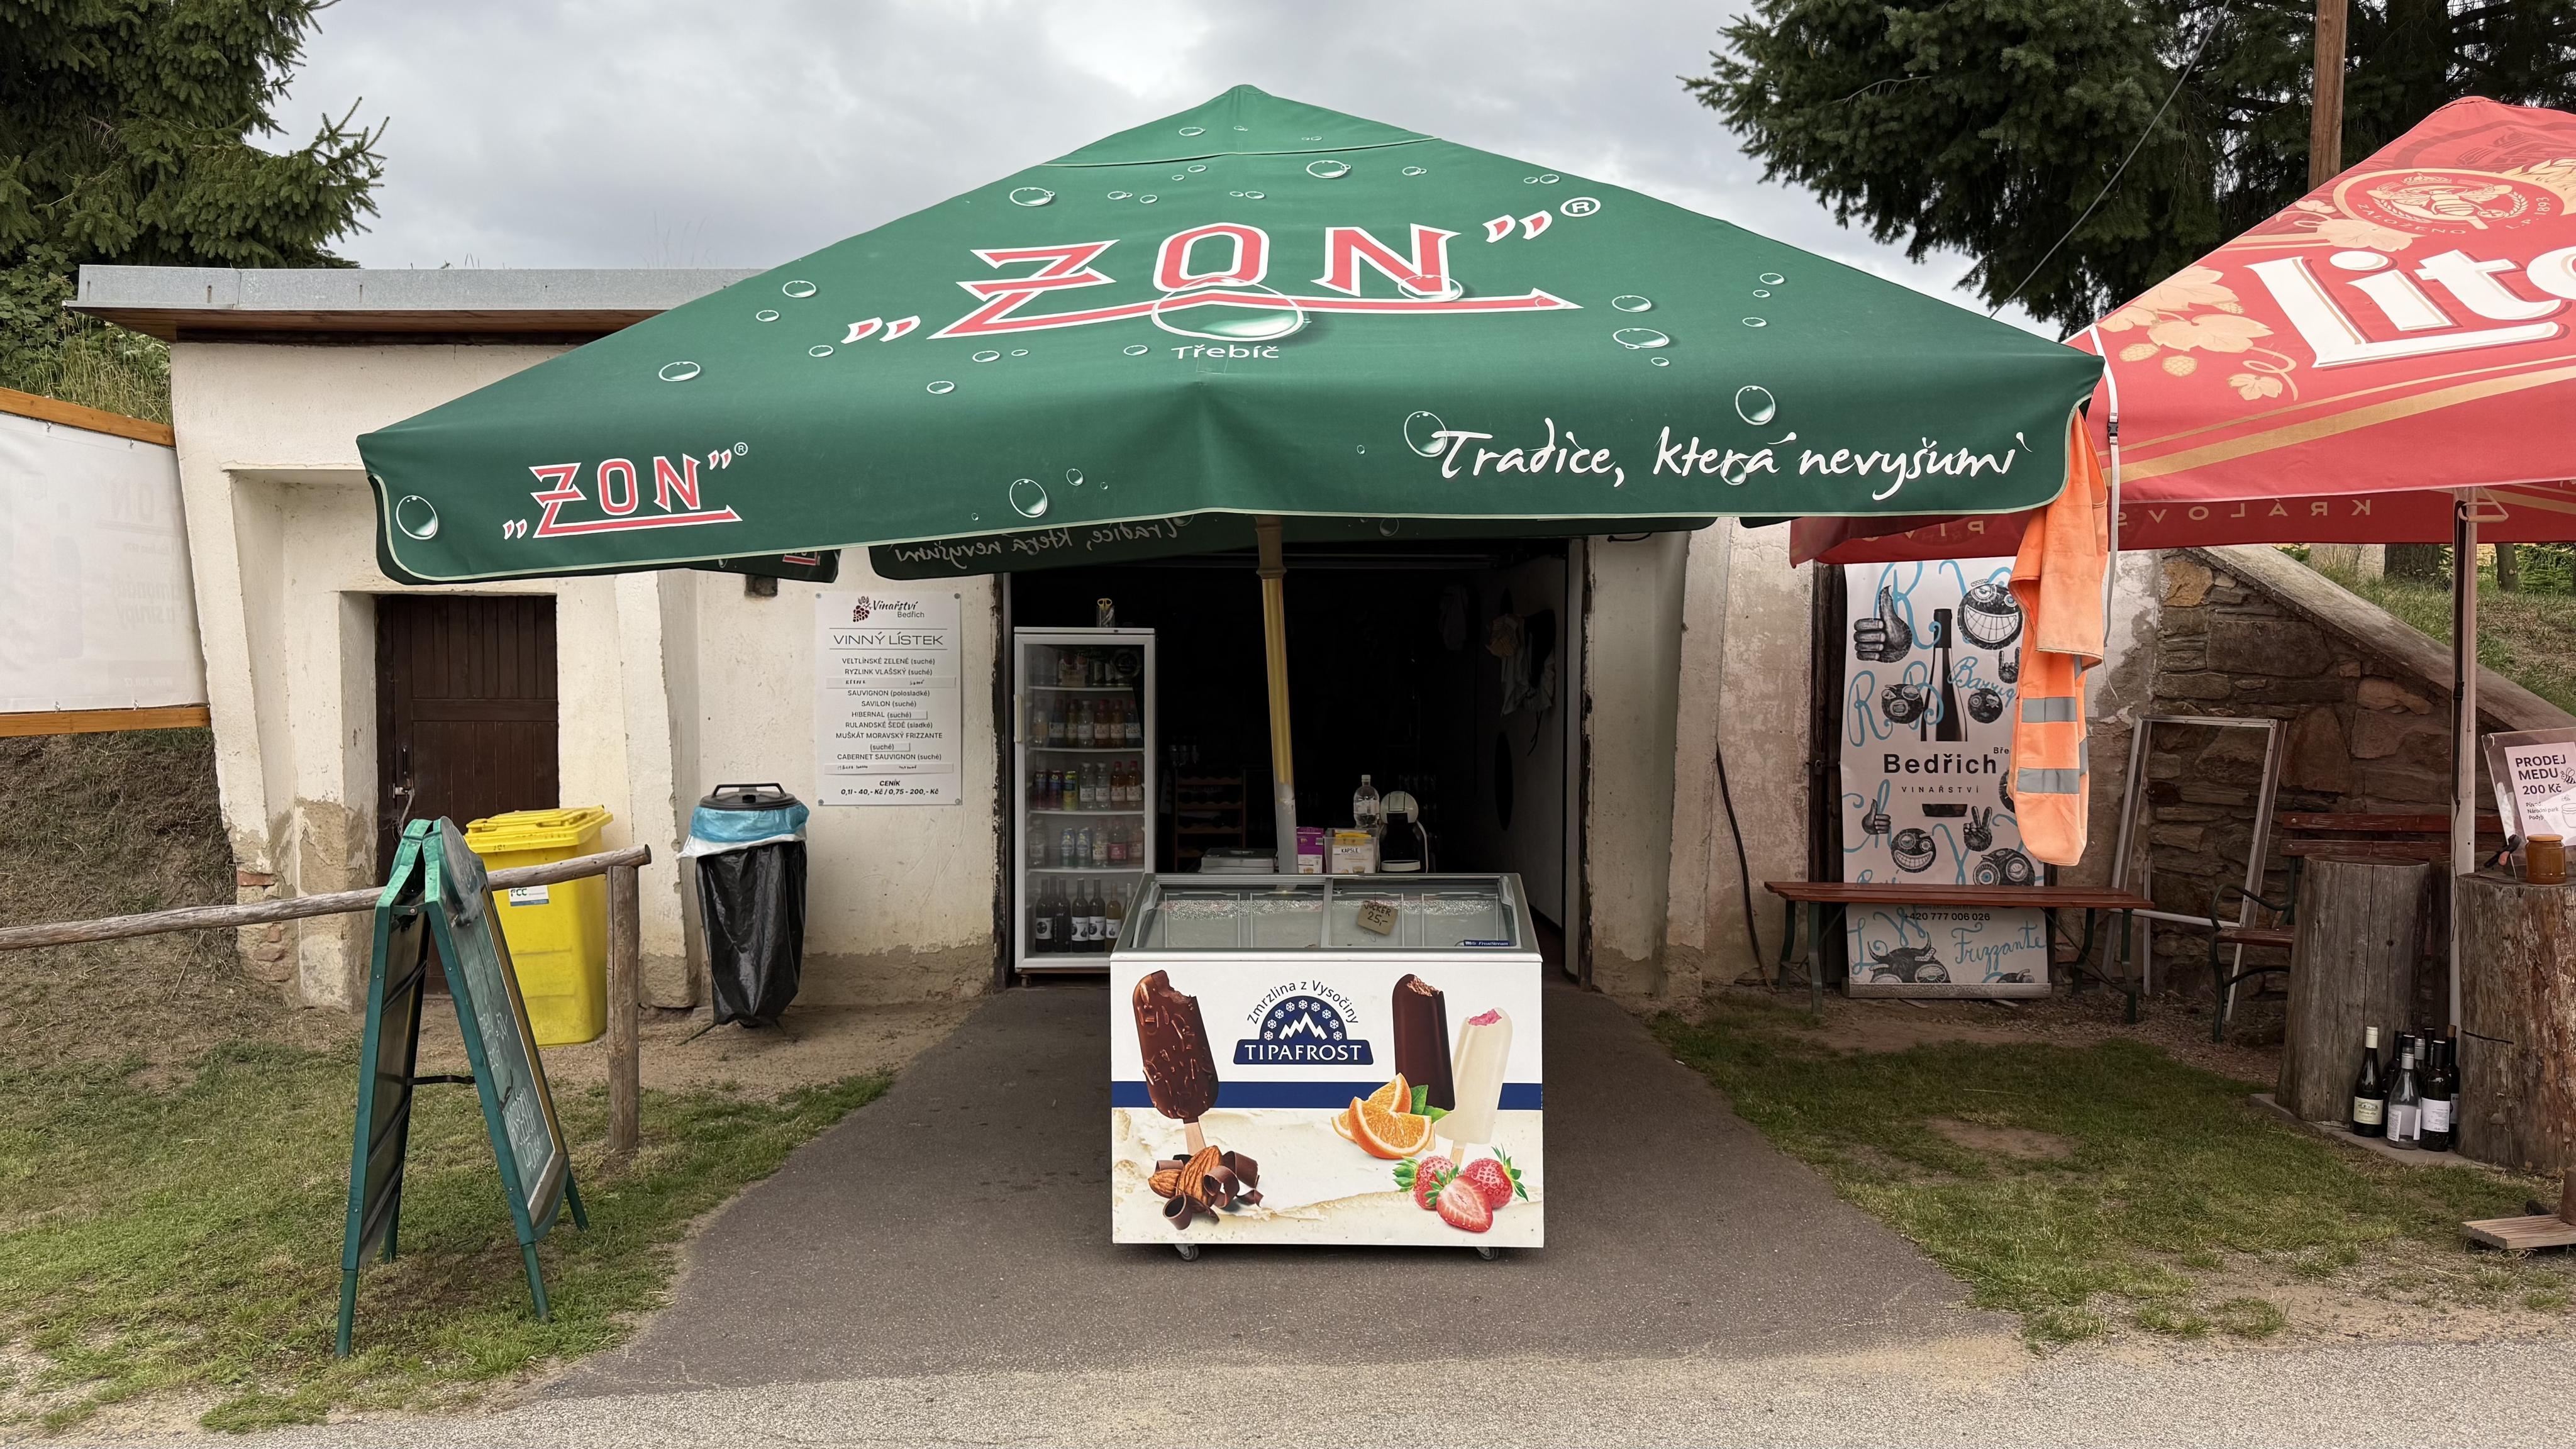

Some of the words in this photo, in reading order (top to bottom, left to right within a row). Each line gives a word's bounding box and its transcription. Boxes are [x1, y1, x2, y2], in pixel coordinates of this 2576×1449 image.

[1170, 341, 1280, 360] Třebíč
[1431, 418, 1624, 487] Tradice,
[1652, 426, 1796, 477] která
[1798, 431, 2032, 501] nevyšumí
[873, 601, 918, 611] Vinařství
[833, 631, 886, 645] VINNÝ
[889, 631, 943, 645] LÍSTEK
[841, 657, 882, 665] VELTLÍNSKÉ
[884, 657, 909, 665] ZELENÉ
[870, 743, 894, 751] (suché)
[1993, 747, 2009, 755] Bře
[1883, 753, 1997, 774] Bedřich
[2515, 754, 2567, 768] PRODEJ
[2518, 767, 2558, 780] MEDU
[1901, 785, 1979, 793] VINAŘSTVÍ
[2522, 784, 2545, 795] 200
[2548, 783, 2562, 793] Kč
[1931, 913, 1949, 921] 777
[1951, 913, 1970, 921] 006
[1972, 913, 1990, 921] 026
[1247, 982, 1296, 1024] Zmrzlina
[1301, 981, 1307, 991] z
[1312, 980, 1359, 1024] Vysočiny
[1244, 1044, 1362, 1061] TIPAFROST
